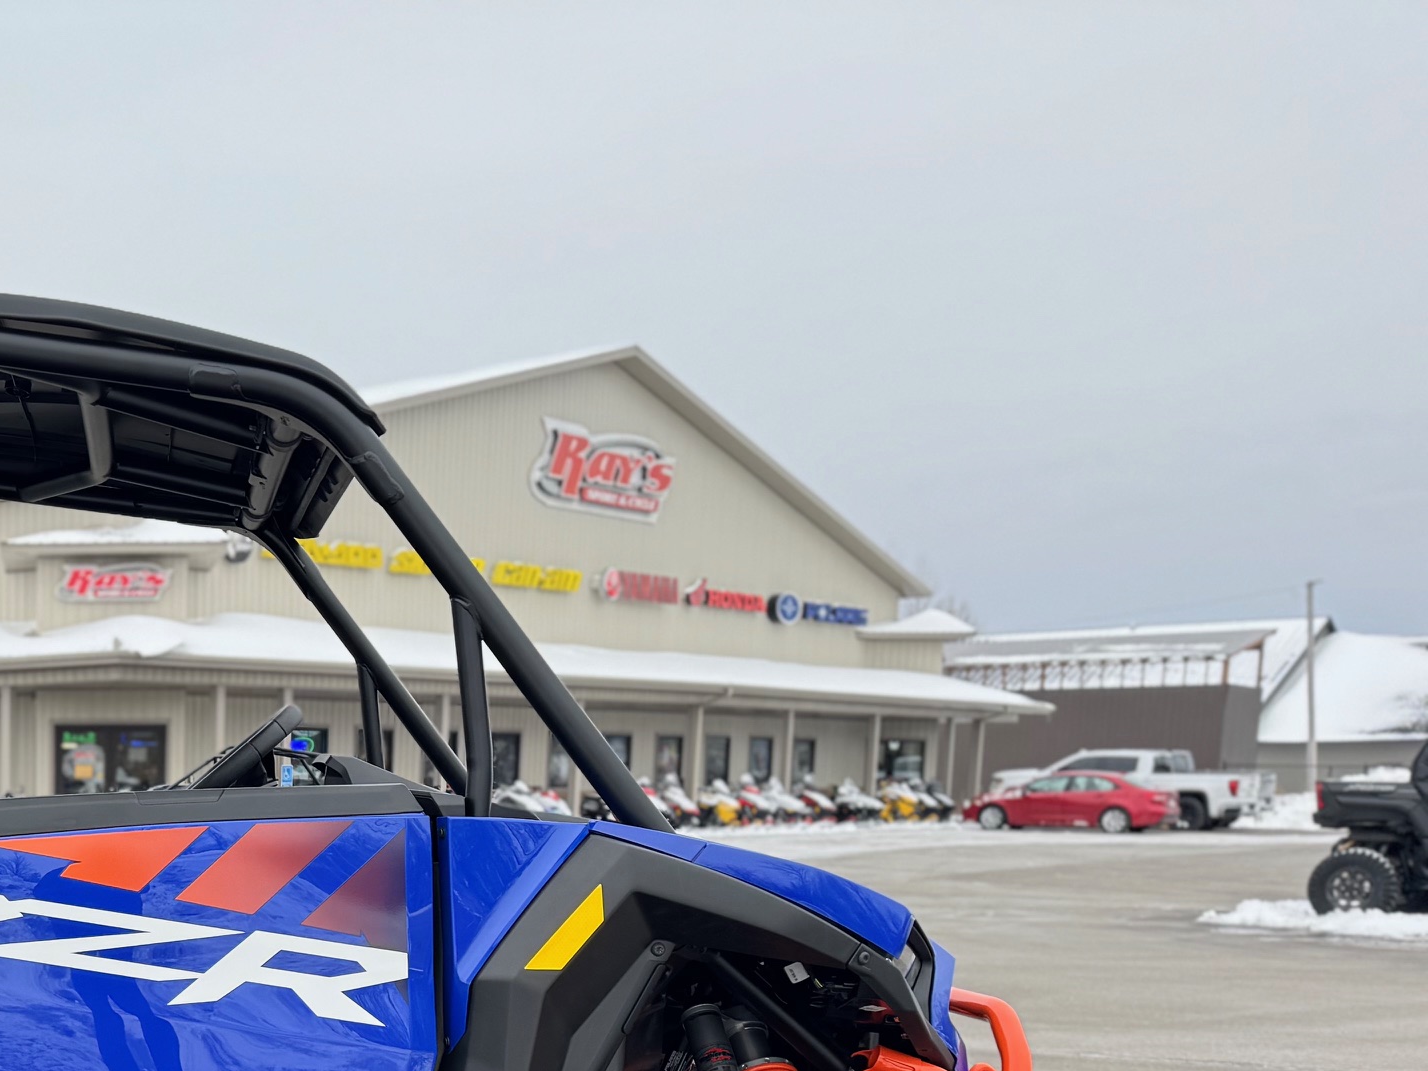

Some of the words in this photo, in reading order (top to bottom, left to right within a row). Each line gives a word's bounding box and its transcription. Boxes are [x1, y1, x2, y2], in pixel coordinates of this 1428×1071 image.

[549, 432, 674, 497] Ray's
[618, 570, 679, 605] YAMAHA
[707, 589, 767, 613] HONDA
